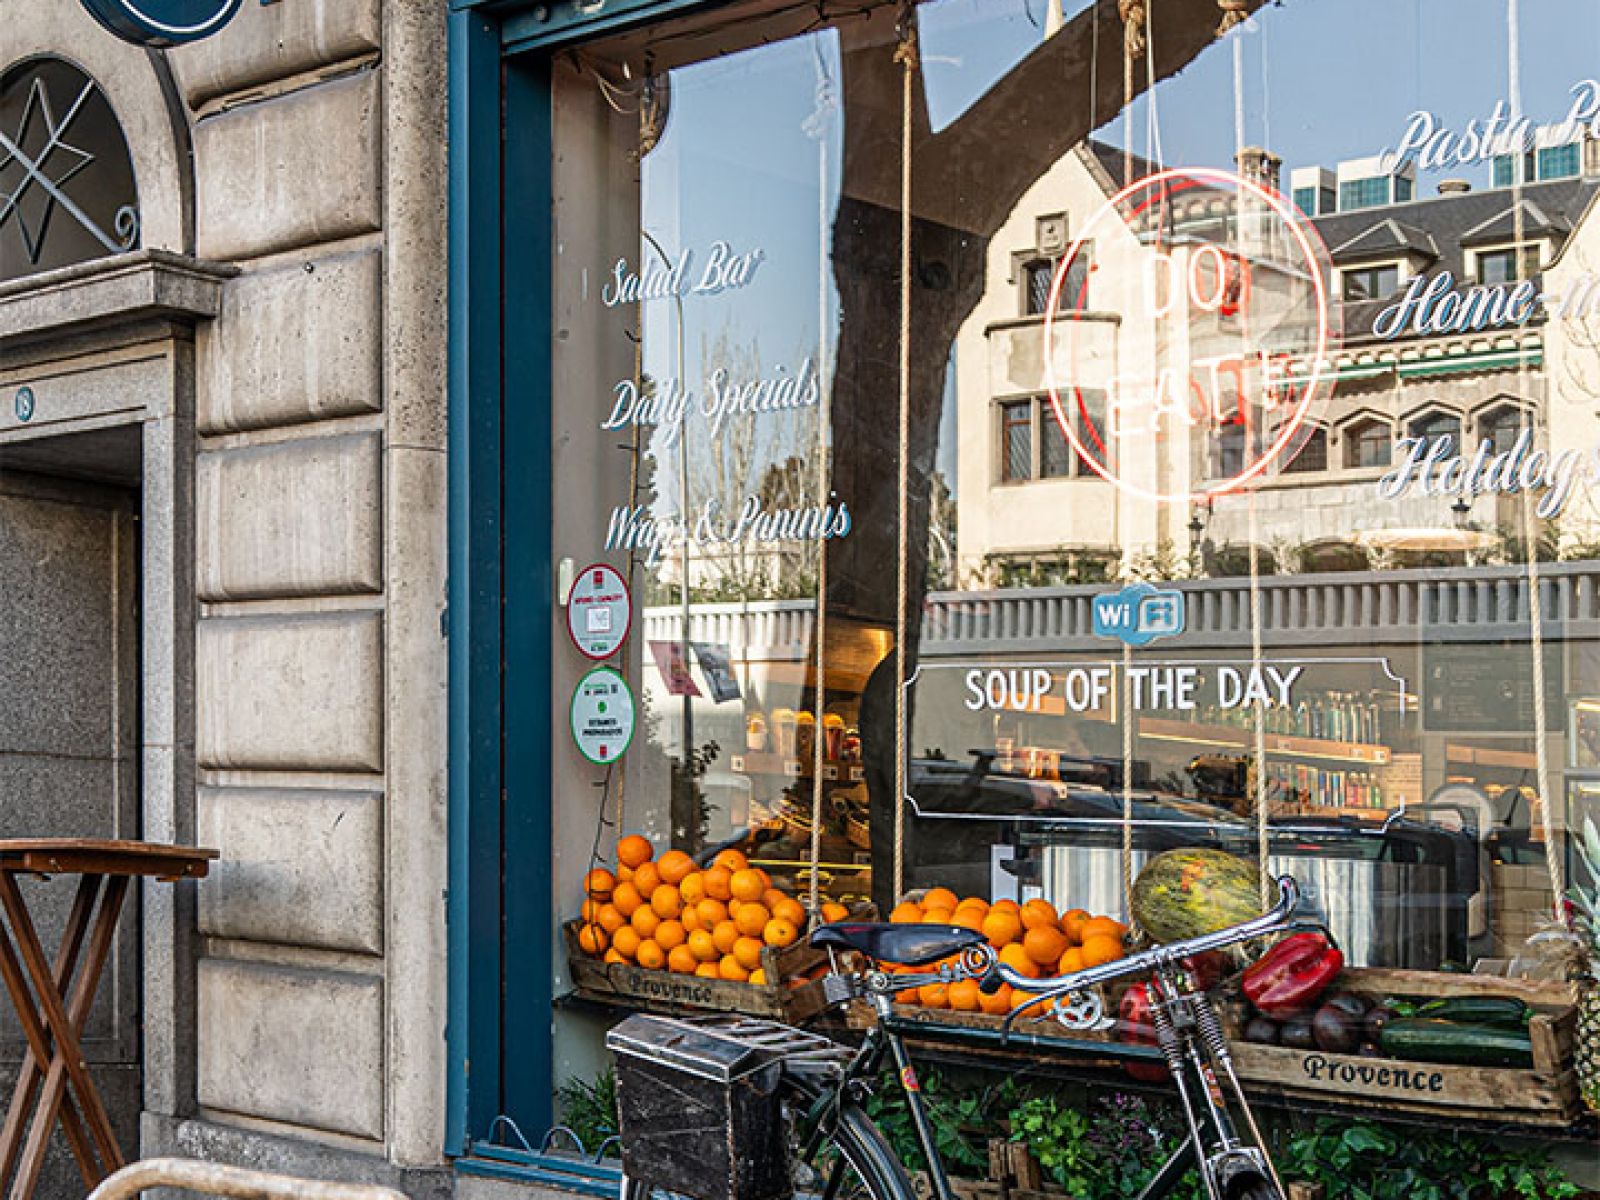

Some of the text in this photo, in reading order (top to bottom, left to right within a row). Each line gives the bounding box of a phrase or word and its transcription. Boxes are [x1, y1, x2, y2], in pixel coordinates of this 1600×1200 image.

[1379, 99, 1536, 175] Pasta
[602, 240, 766, 307] Salad Bar
[600, 356, 820, 447] Daily Specials
[604, 503, 687, 567] Wrap
[728, 491, 852, 542] Paninis
[964, 666, 1302, 711] SOUP OF THE DAY
[628, 971, 713, 1004] Provence
[1303, 1054, 1444, 1093] Provence
